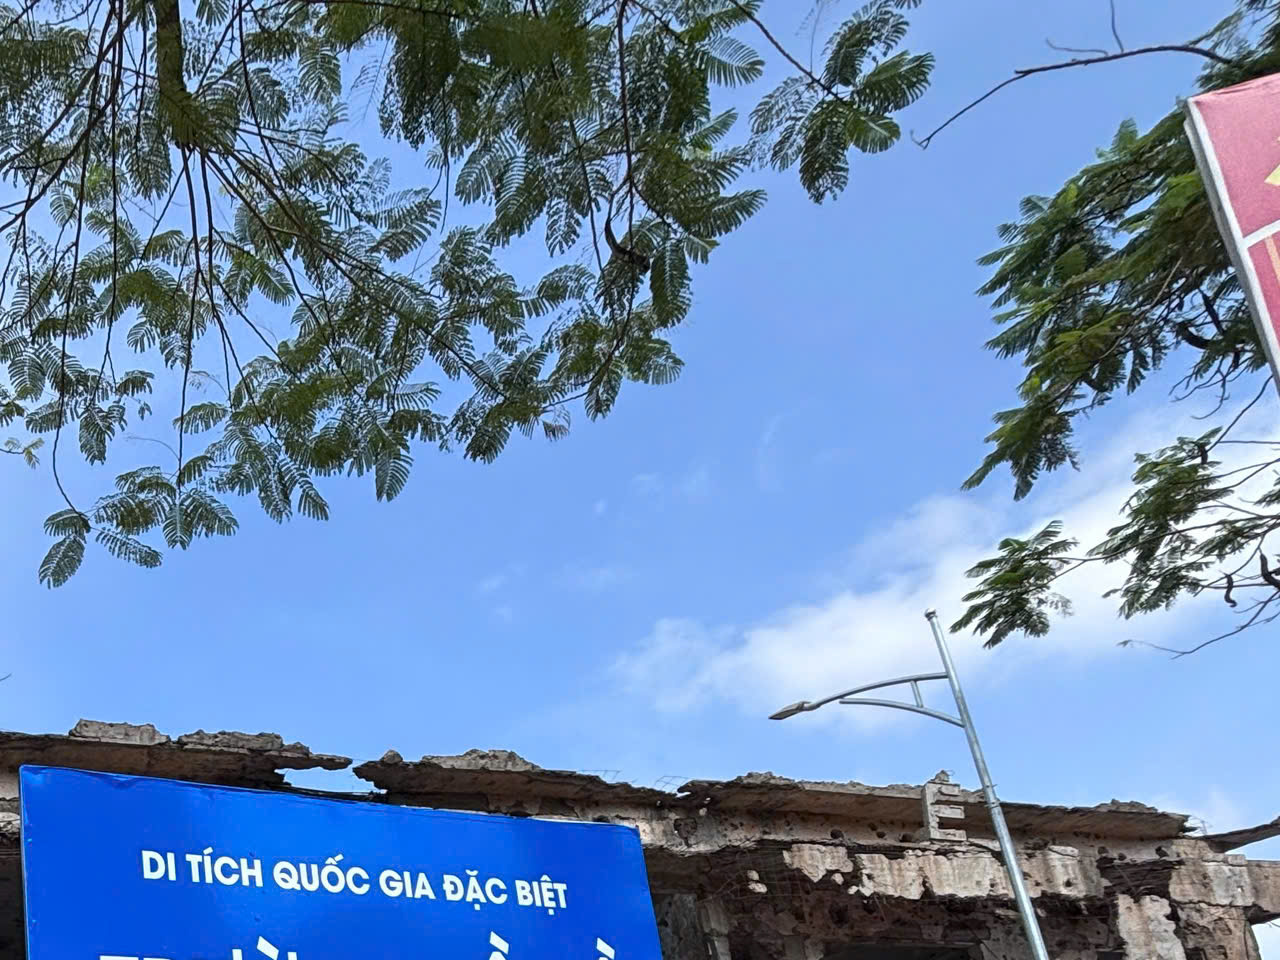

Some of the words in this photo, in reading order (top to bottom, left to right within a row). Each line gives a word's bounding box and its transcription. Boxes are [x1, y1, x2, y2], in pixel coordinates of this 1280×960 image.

[141, 850, 178, 881] DI
[185, 846, 264, 887] TÍCH
[272, 852, 370, 895] QUỐC
[378, 869, 436, 900] GIA
[442, 869, 508, 911] ĐẶC
[515, 874, 568, 916] BIỆT
